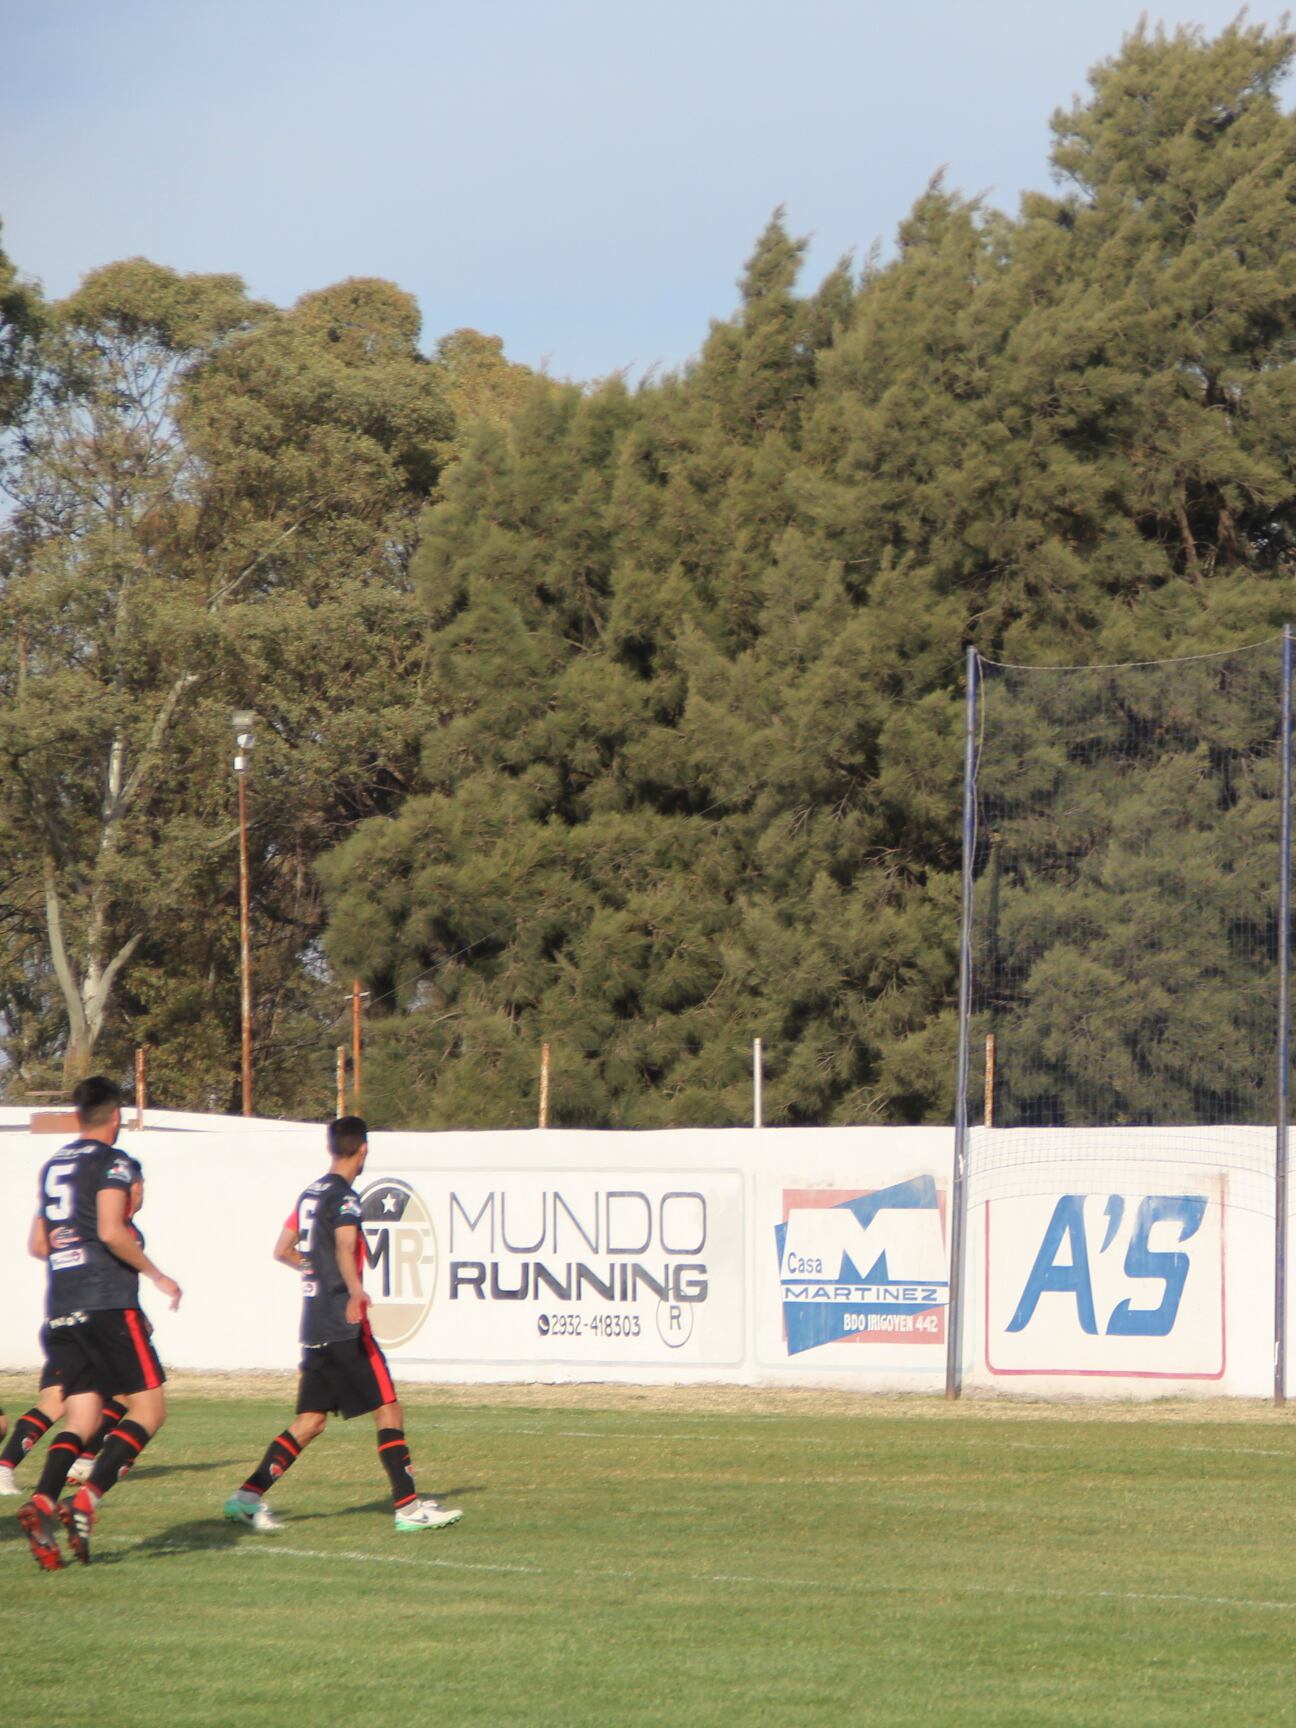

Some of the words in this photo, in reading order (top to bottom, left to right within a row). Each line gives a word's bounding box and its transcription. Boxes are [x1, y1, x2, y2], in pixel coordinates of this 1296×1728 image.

[45, 1163, 78, 1221] 5
[449, 1190, 706, 1255] MUNDO
[787, 1252, 823, 1274] Casa
[1005, 1194, 1208, 1336] A'S
[449, 1261, 709, 1303] RUNNING
[785, 1287, 938, 1302] MARTINEZ
[551, 1314, 641, 1338] 2932-418303
[843, 1313, 865, 1331] BDO
[867, 1313, 913, 1332] IRIGOYEN
[915, 1315, 938, 1333] 442
